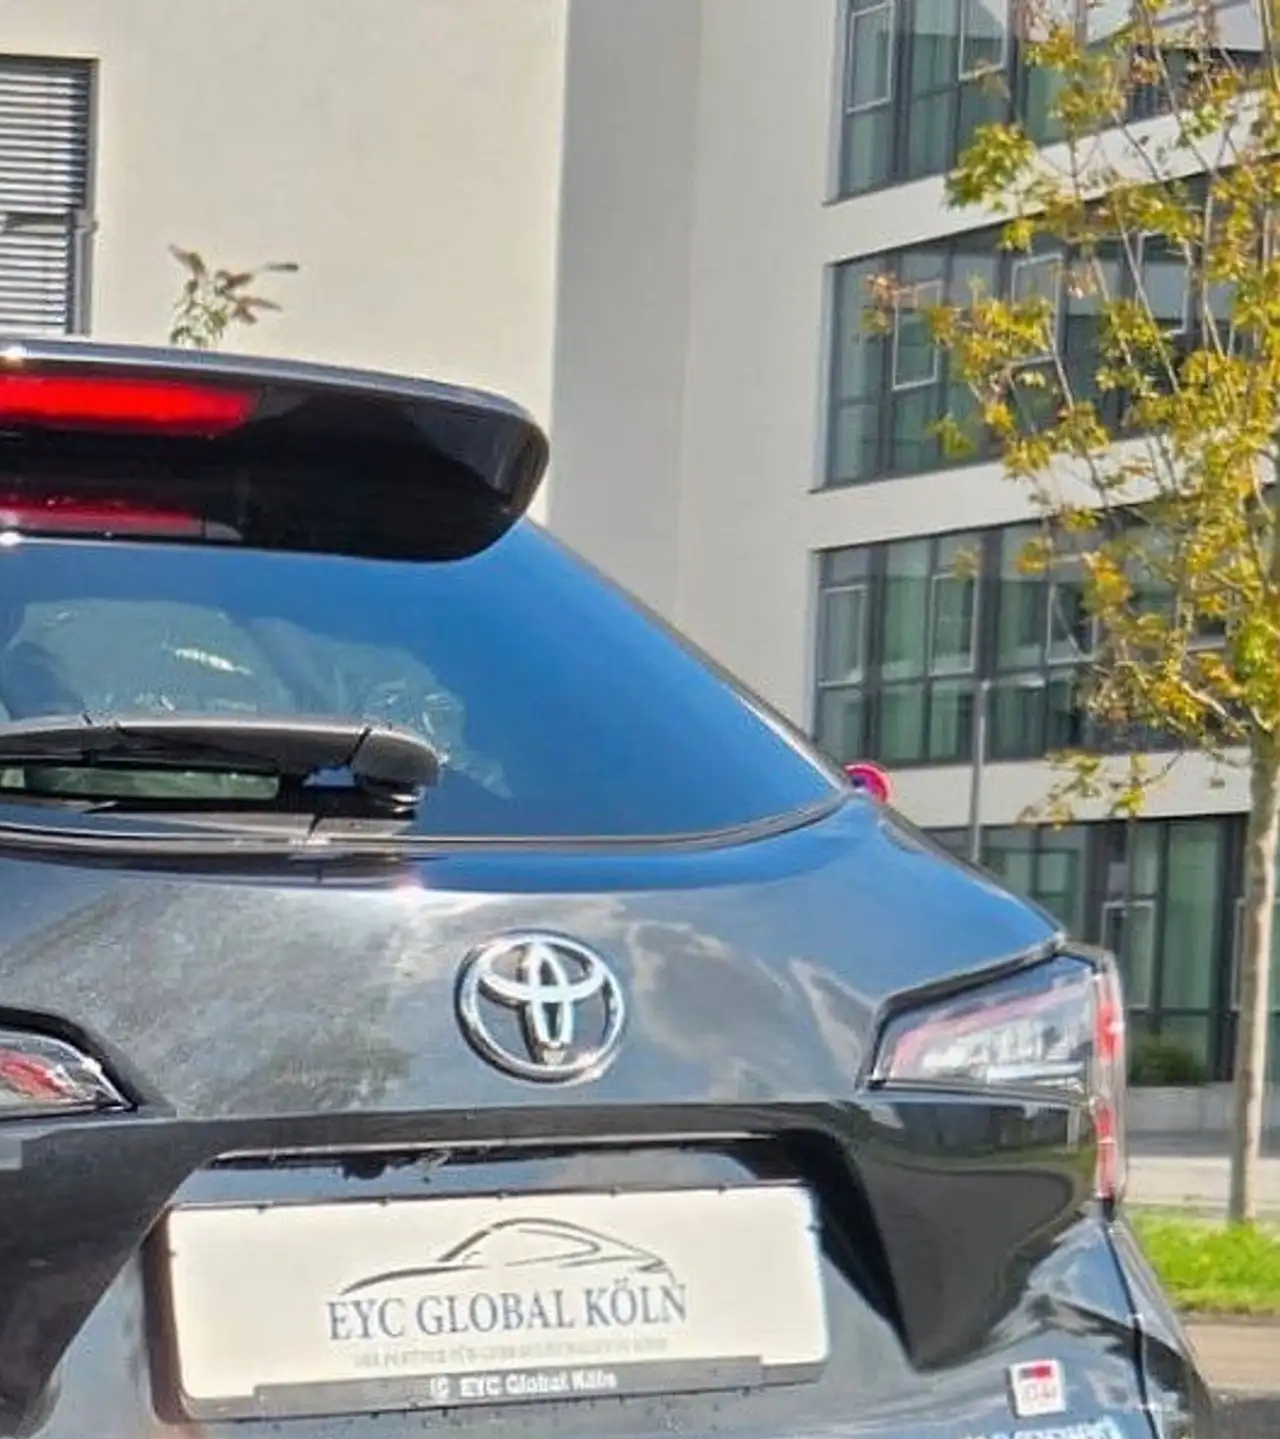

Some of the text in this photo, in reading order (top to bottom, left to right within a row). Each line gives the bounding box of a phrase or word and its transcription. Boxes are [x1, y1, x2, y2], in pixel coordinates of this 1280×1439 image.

[329, 1277, 688, 1340] EYC GLOBAL KÖLN
